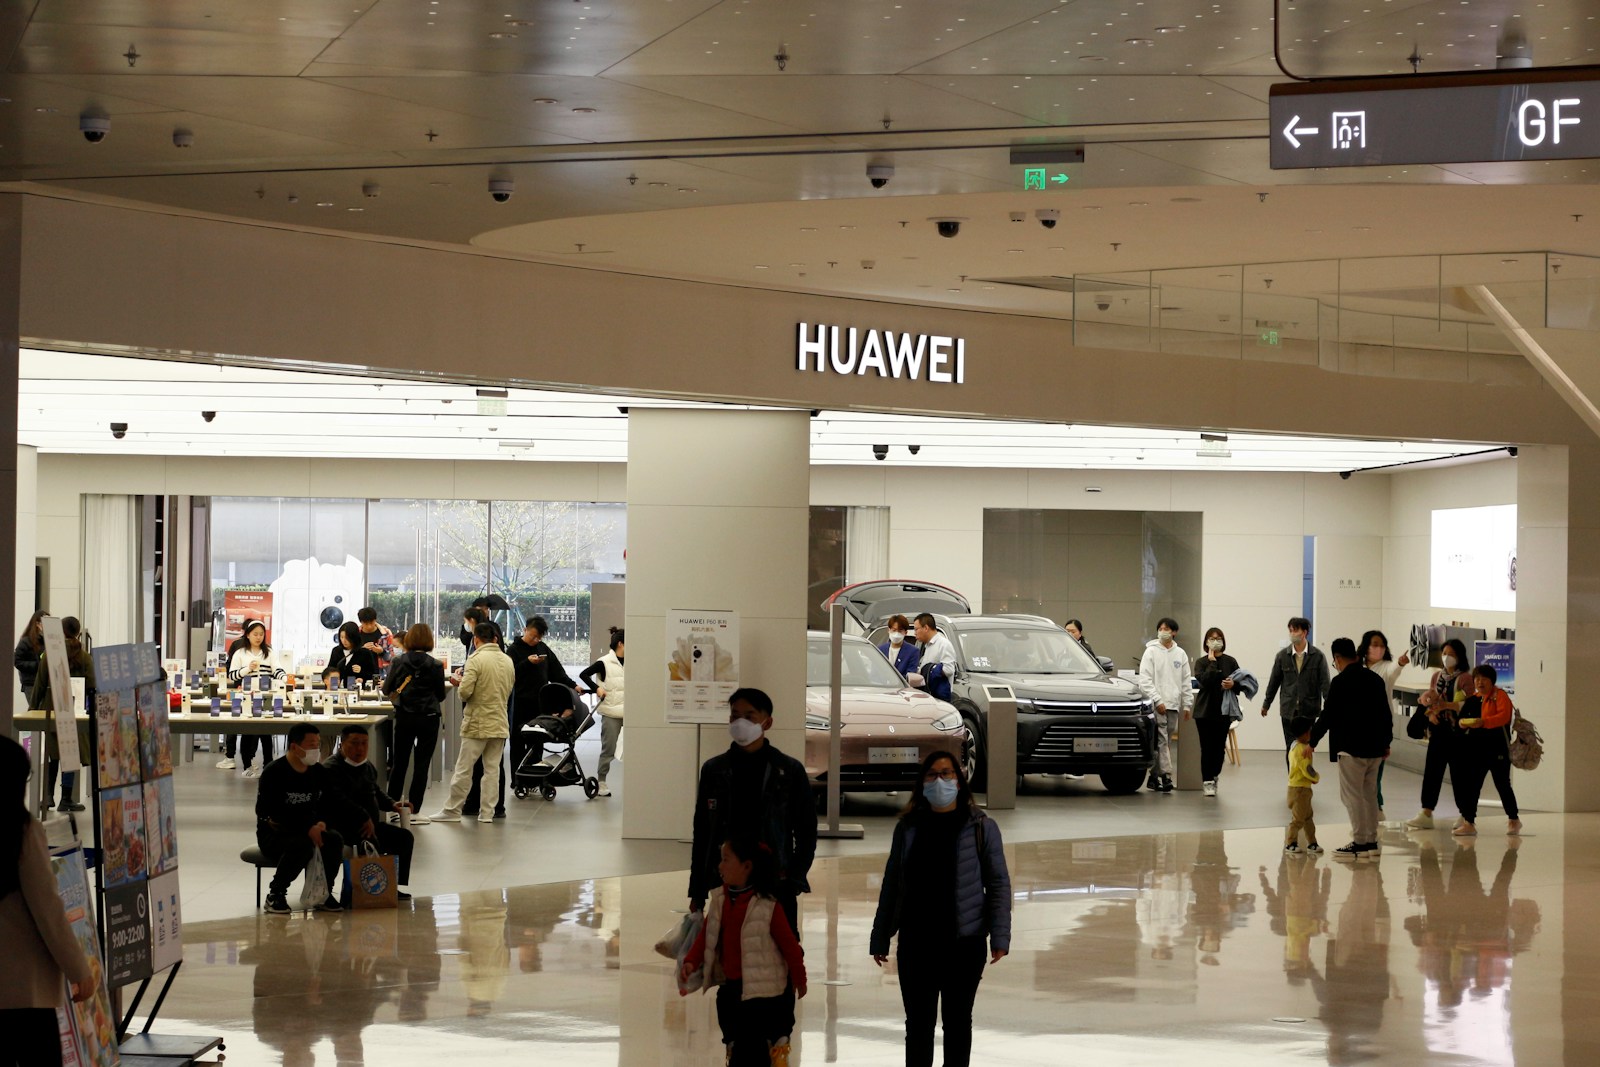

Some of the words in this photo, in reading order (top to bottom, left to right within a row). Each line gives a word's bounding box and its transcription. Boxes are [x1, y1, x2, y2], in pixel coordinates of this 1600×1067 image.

[1518, 98, 1581, 147] GF
[796, 321, 965, 384] HUAWEI
[112, 924, 145, 949] 9:00-22:00
